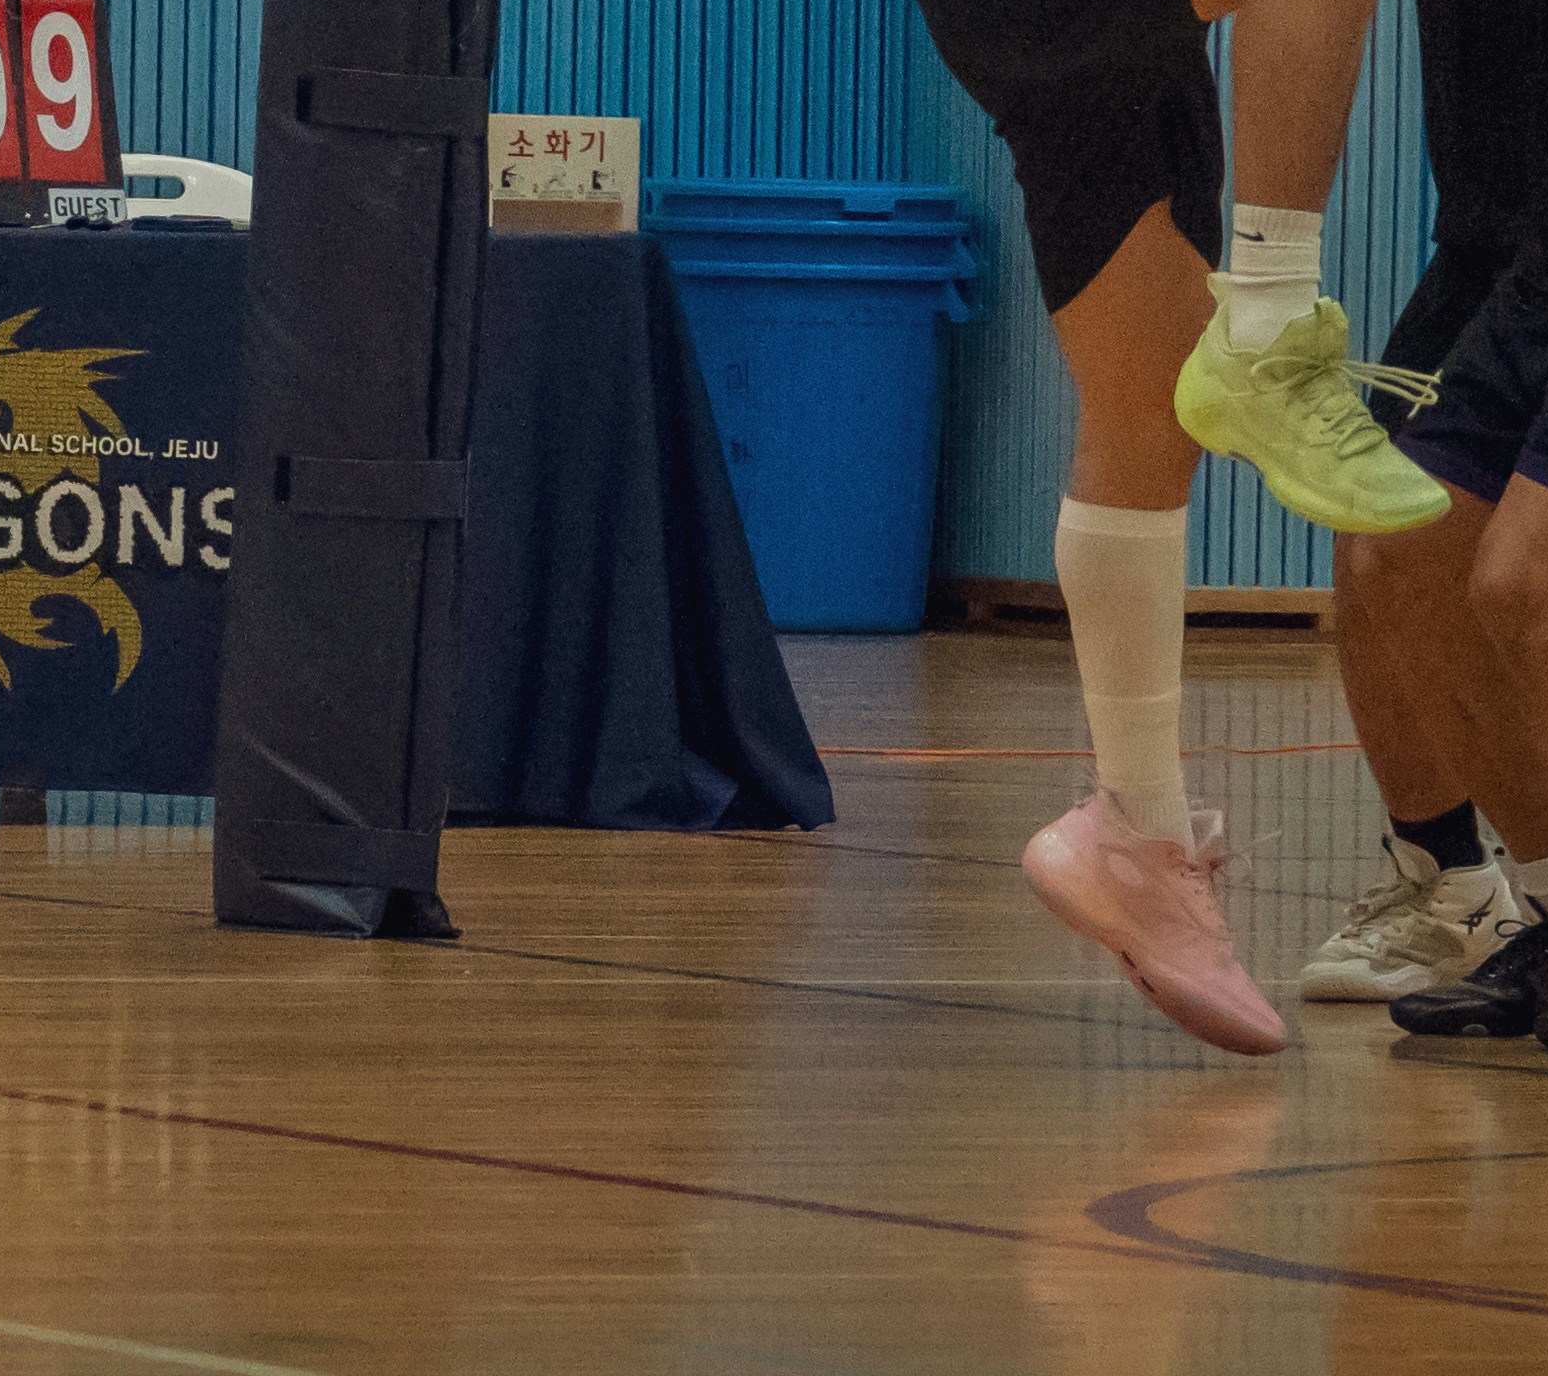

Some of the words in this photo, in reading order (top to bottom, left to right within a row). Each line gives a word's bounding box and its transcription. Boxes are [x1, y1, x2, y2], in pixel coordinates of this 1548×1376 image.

[507, 129, 605, 163] 소화기
[54, 196, 122, 219] GUEST
[50, 433, 155, 461] SCHOOL,
[161, 440, 219, 461] JEJU
